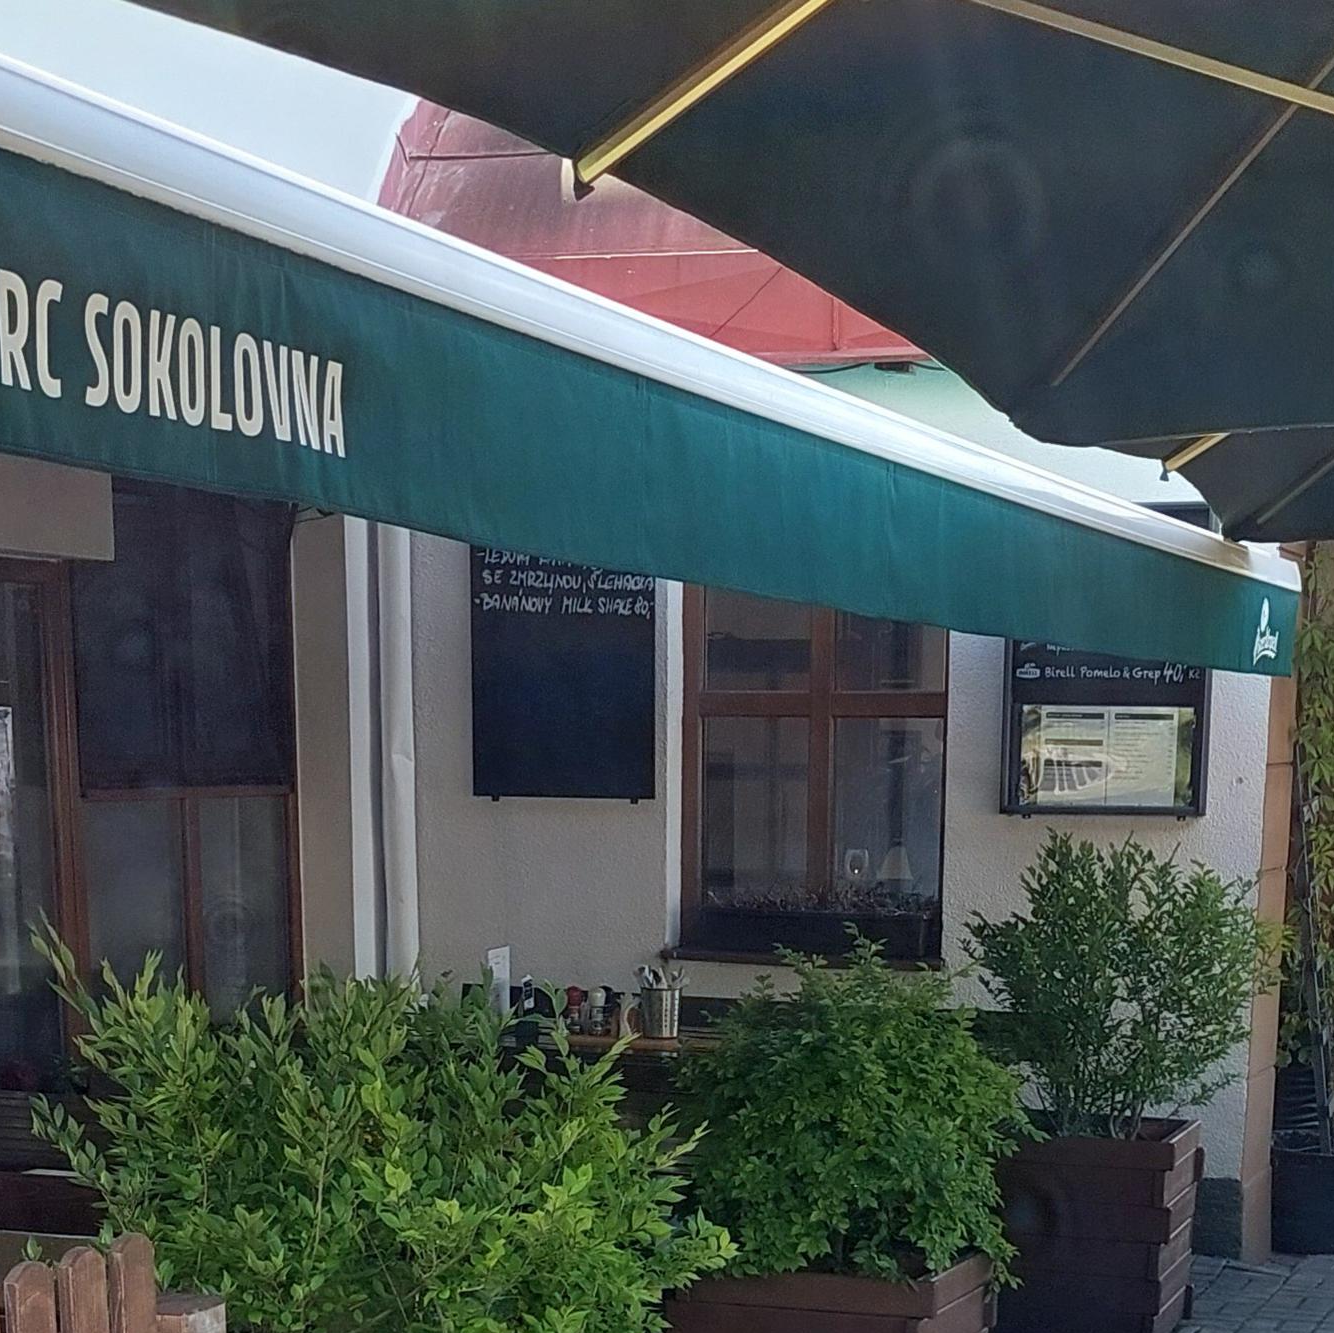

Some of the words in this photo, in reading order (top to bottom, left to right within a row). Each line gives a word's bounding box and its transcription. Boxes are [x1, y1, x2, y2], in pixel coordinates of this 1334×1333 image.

[84, 292, 346, 459] SOKOLOVNA
[482, 569, 504, 584] SE
[561, 596, 593, 614] MILK
[598, 597, 633, 615] SHAKE
[1044, 667, 1075, 679] Birell
[1080, 666, 1121, 679] Pomelo
[1132, 667, 1161, 686] Grep
